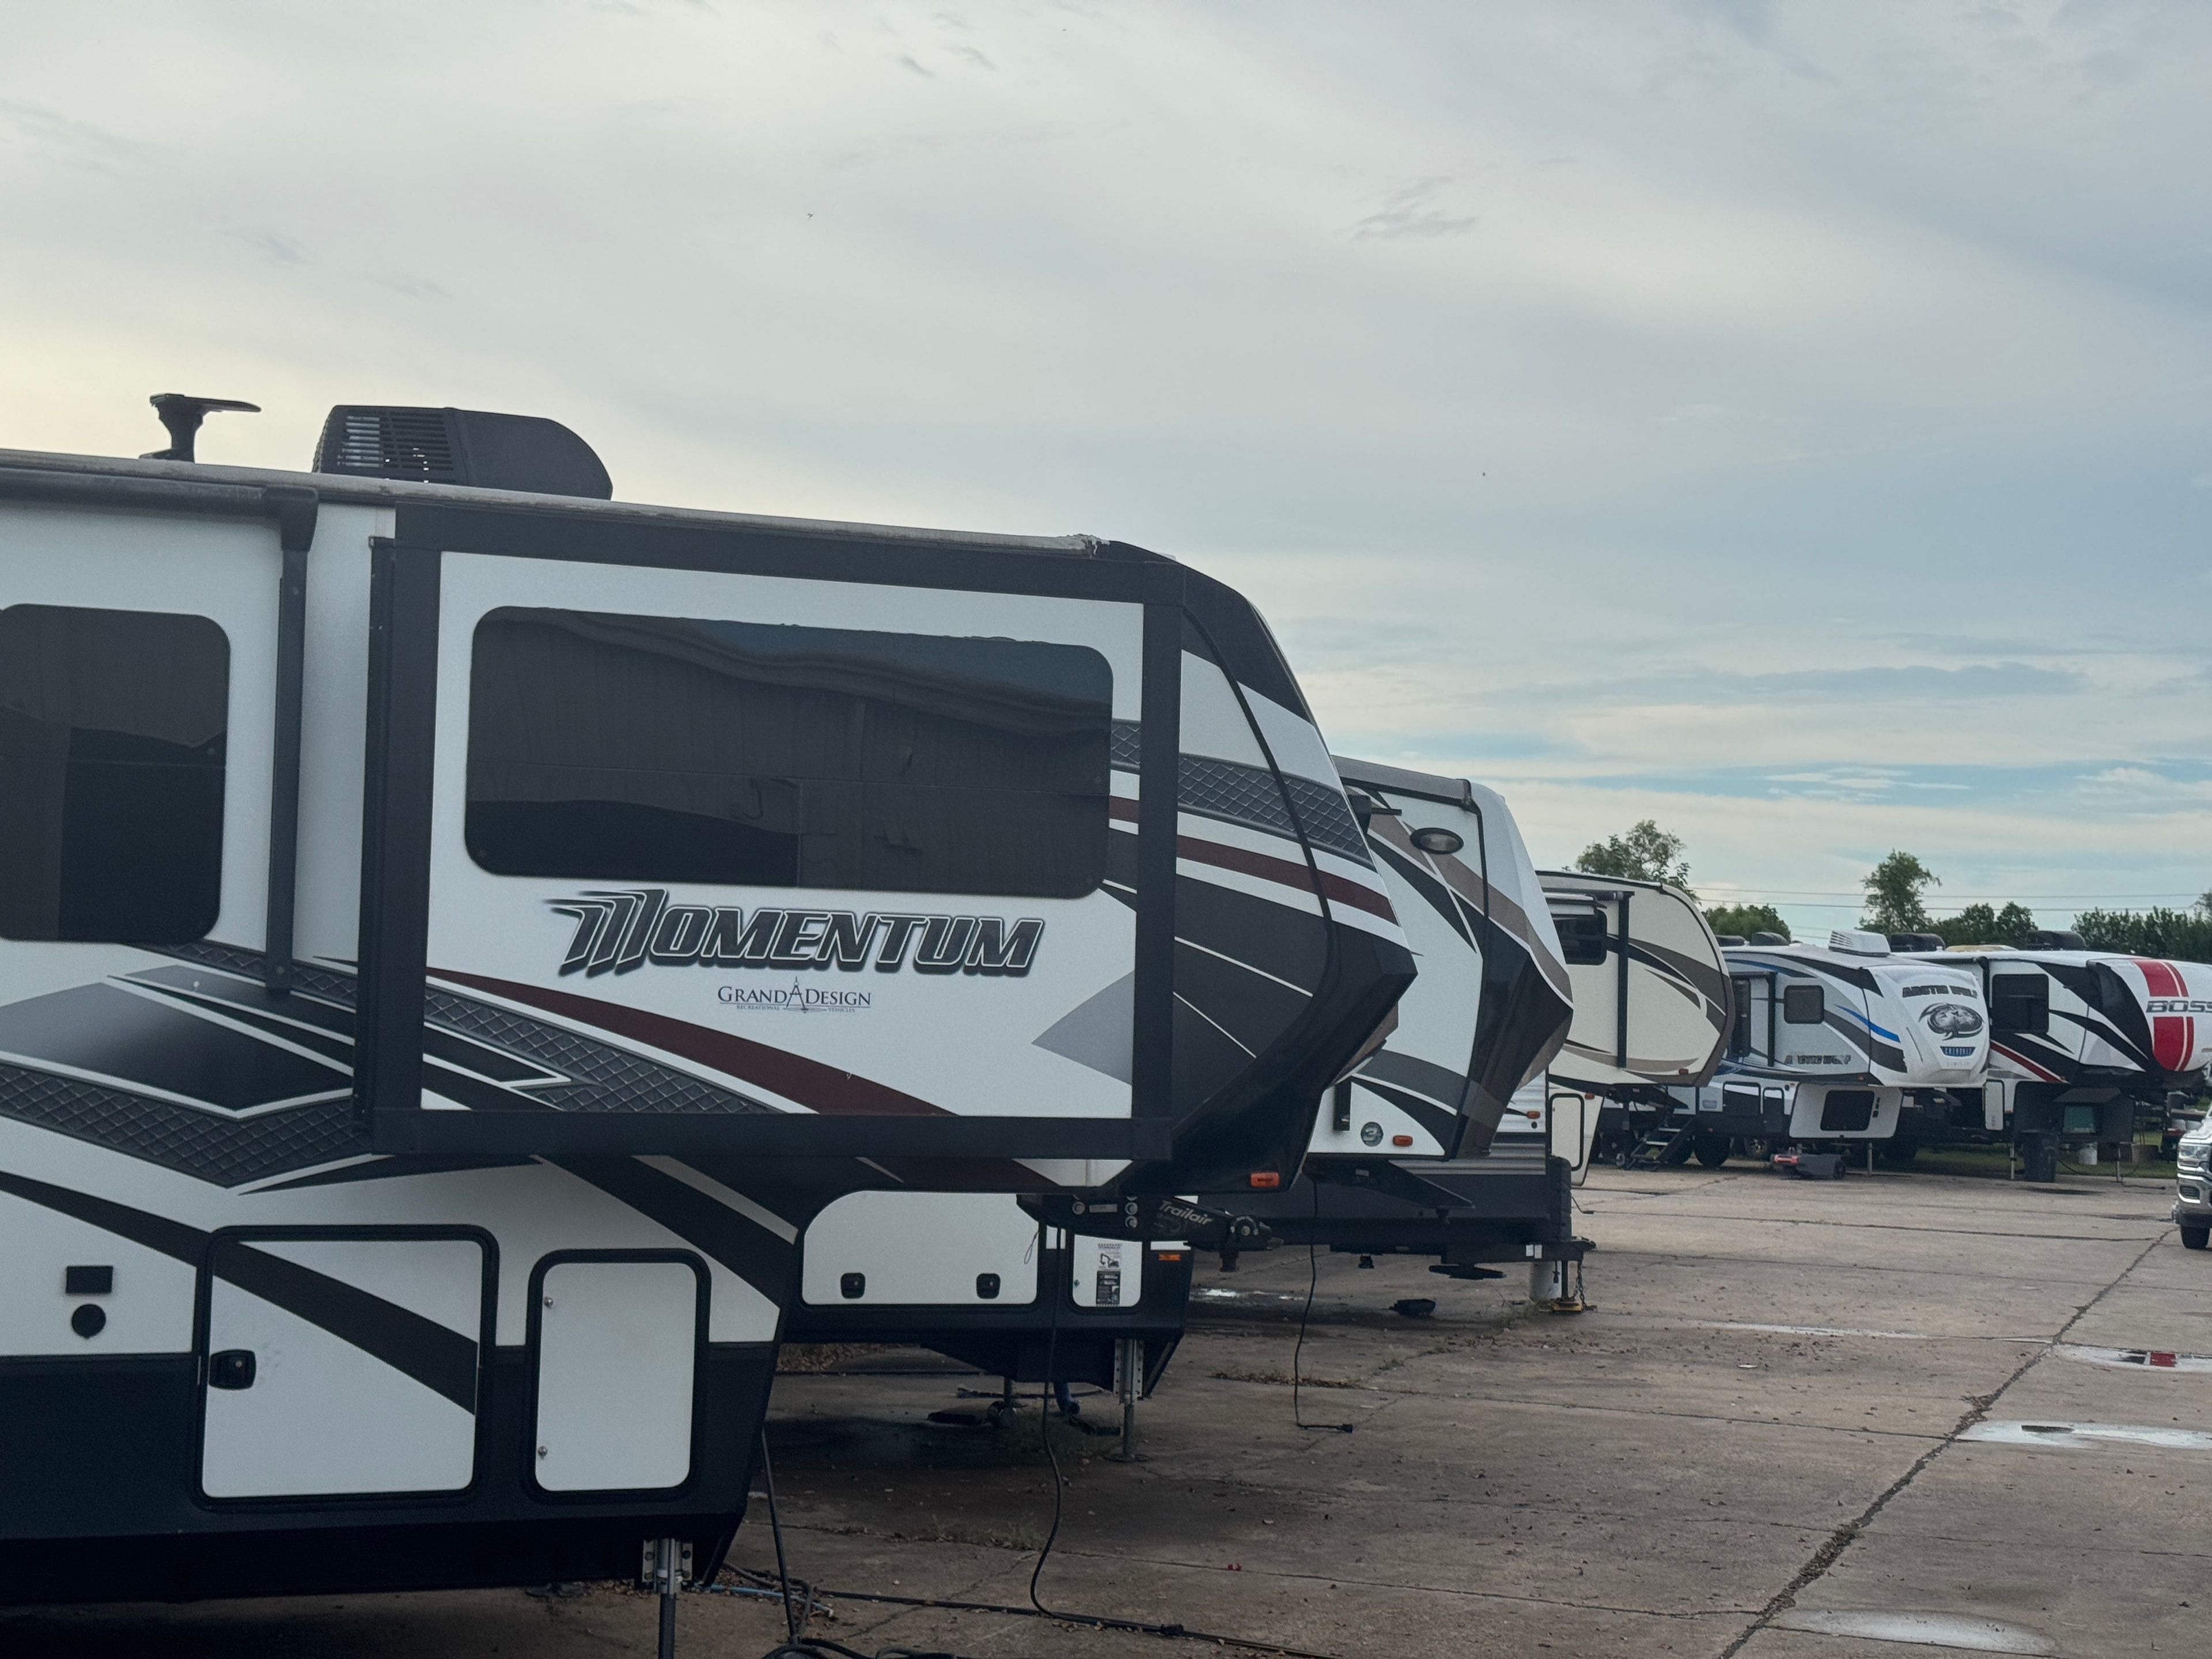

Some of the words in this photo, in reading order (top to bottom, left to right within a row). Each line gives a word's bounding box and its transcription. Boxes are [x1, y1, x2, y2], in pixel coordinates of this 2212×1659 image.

[543, 889, 1045, 978] MOMENTUM
[718, 986, 787, 1003] GRAND
[805, 988, 871, 1006] DESIGN
[1158, 1200, 1214, 1226] Trailair
